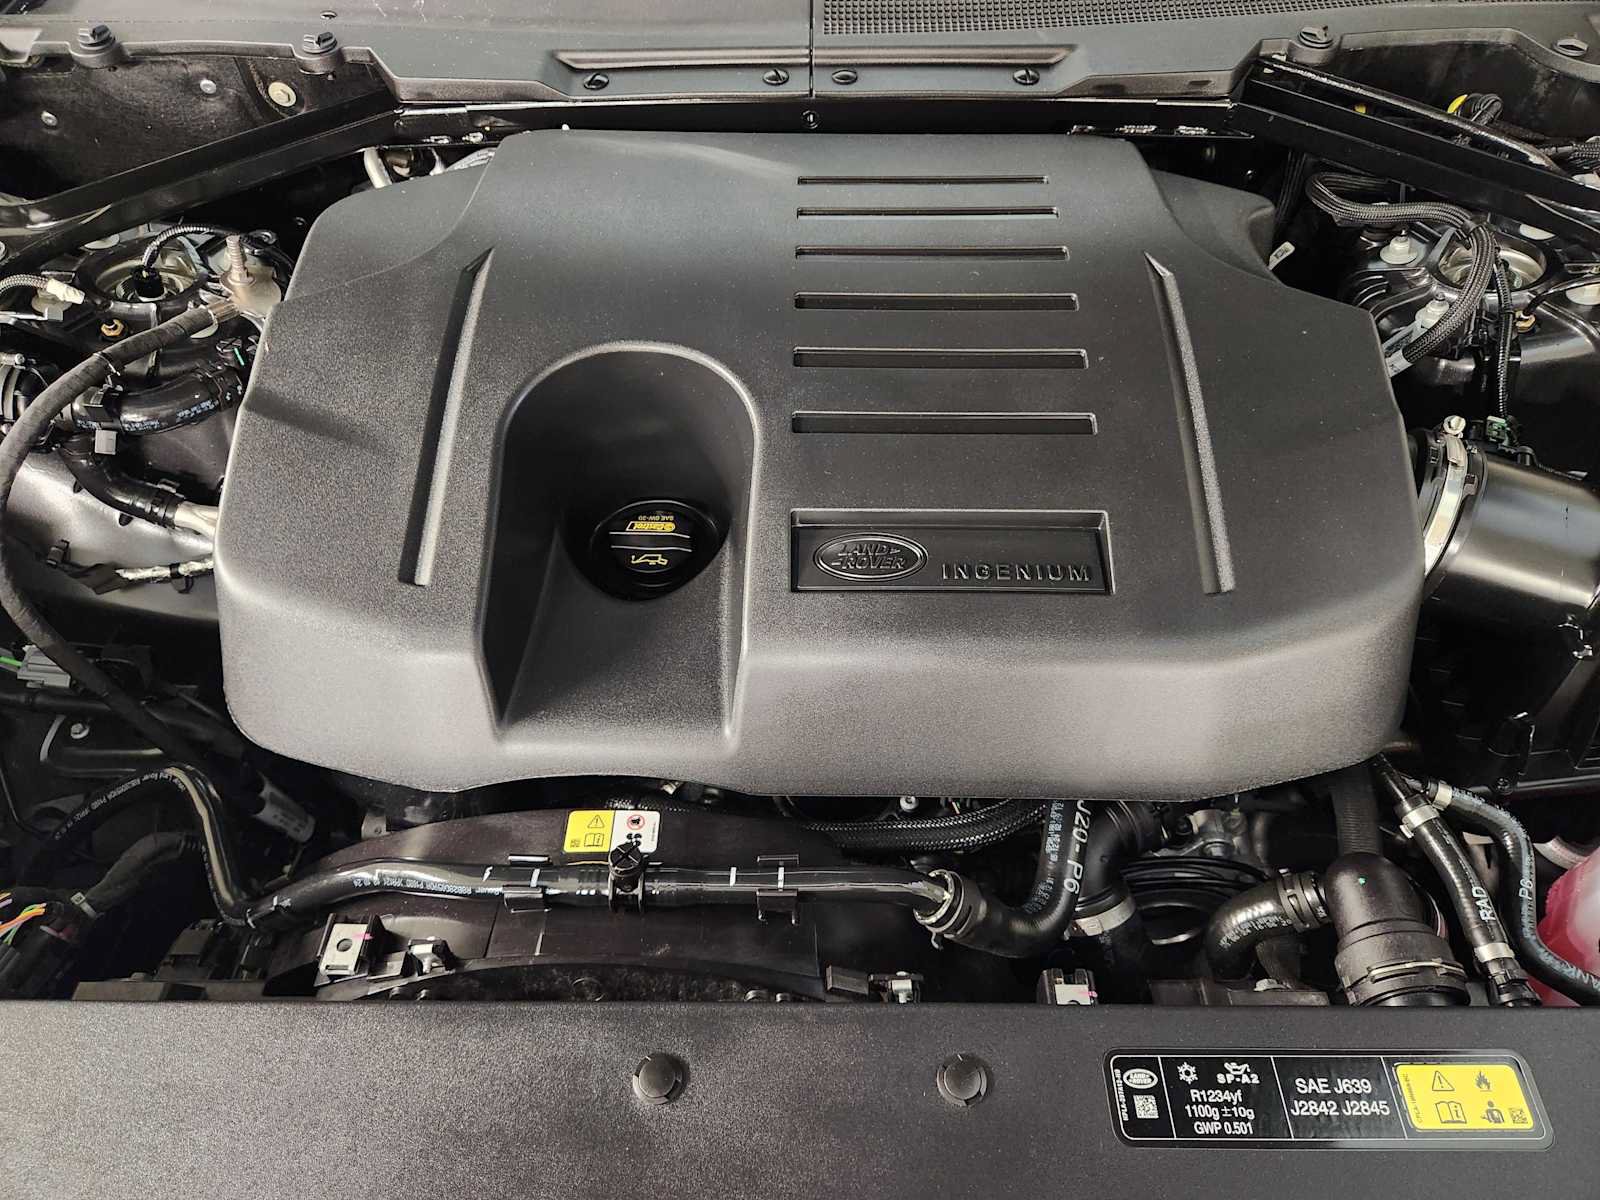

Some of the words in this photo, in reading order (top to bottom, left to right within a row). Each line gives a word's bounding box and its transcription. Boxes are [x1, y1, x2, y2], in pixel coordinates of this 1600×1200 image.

[838, 542, 888, 556] LAND
[841, 556, 906, 570] ROVER
[941, 562, 1091, 582] INGENIUM
[1471, 886, 1496, 922] RAD
[1295, 1078, 1332, 1095] SAE
[1333, 1078, 1373, 1095] J639
[1190, 1089, 1244, 1106] R1234yf
[1291, 1099, 1340, 1117] J2842
[1342, 1100, 1391, 1117] J2845
[1193, 1121, 1223, 1136] GWP
[1224, 1121, 1255, 1136] 0.501
